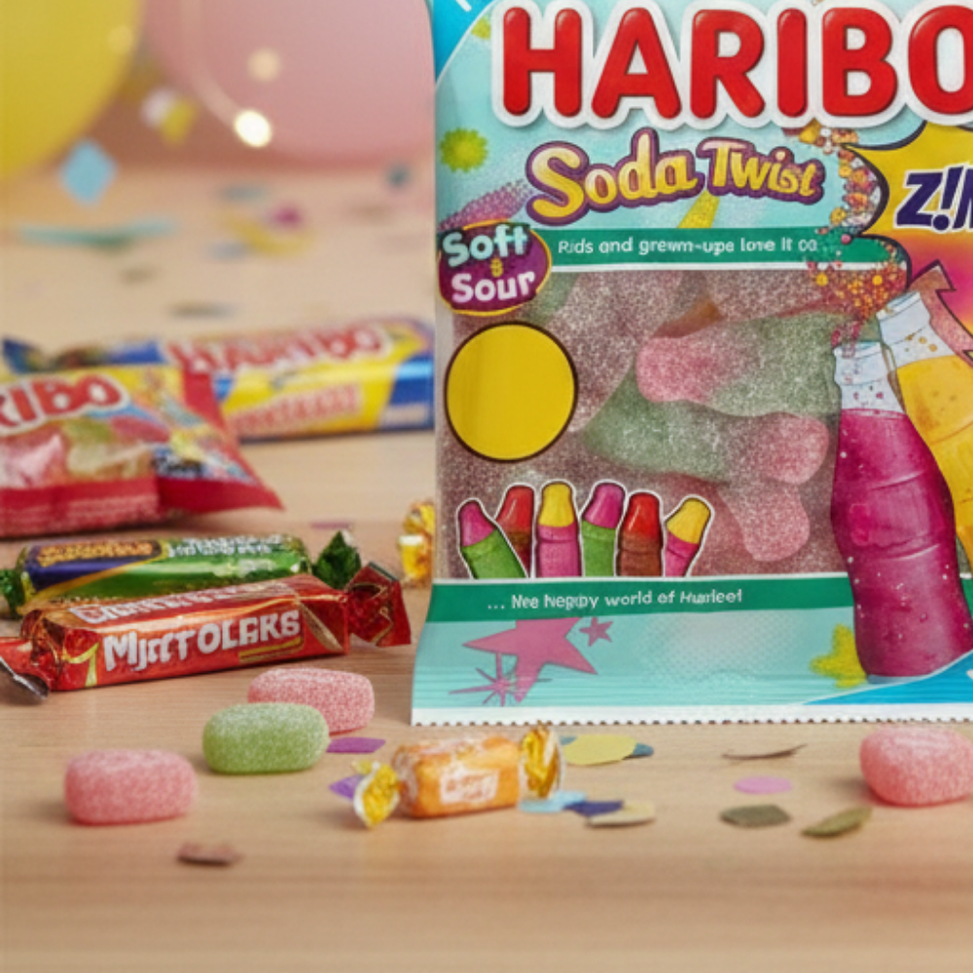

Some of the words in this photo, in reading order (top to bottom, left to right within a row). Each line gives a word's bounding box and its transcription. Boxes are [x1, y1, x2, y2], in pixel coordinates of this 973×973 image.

[528, 129, 703, 222] Soda
[697, 137, 825, 203] Twist
[442, 224, 528, 267] Soft
[598, 236, 634, 254] and
[451, 271, 535, 303] Sour
[604, 590, 653, 607] world
